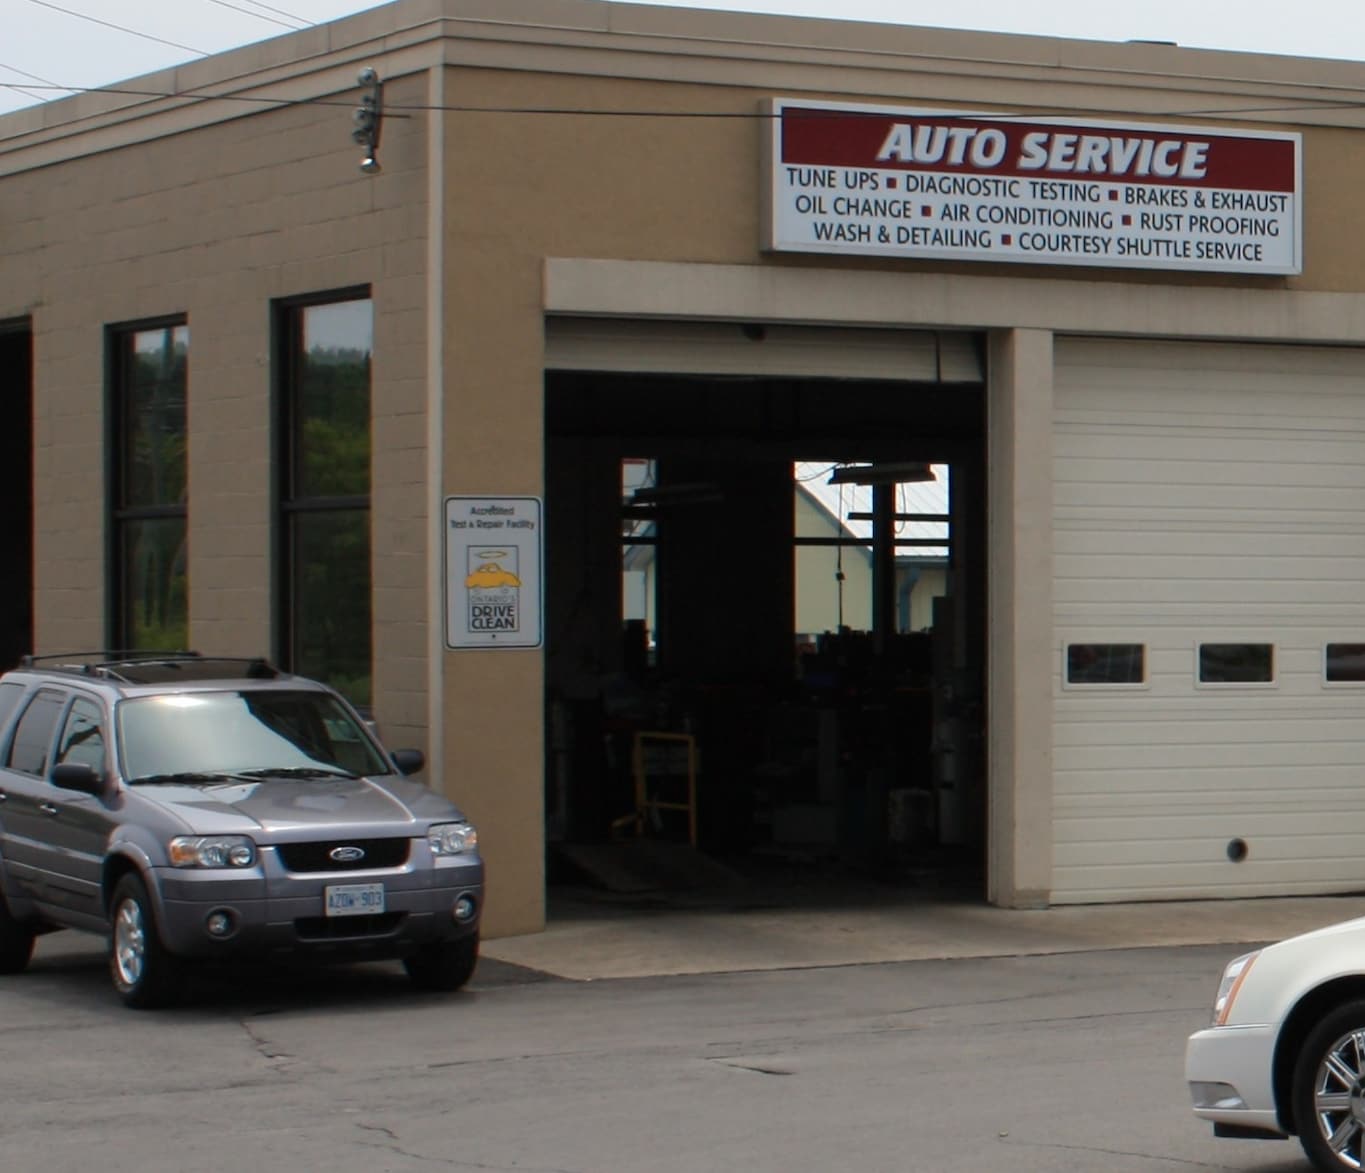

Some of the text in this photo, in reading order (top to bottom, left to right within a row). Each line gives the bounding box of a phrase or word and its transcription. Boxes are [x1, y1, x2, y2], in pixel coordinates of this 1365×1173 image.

[875, 122, 1210, 179] AUTO SERVICE
[786, 167, 1289, 213] TUNE UPS DIAGNOSTIC TESTING BRAKES & EXHAUST
[795, 194, 1280, 237] OIL CHANGE AIR CONDITIONING RUST PROOFING
[814, 222, 1264, 262] WASH & DETAILING COURTESY SHUTTLE SERVICE
[471, 605, 515, 617] DRIVE
[471, 618, 515, 630] CLEAN
